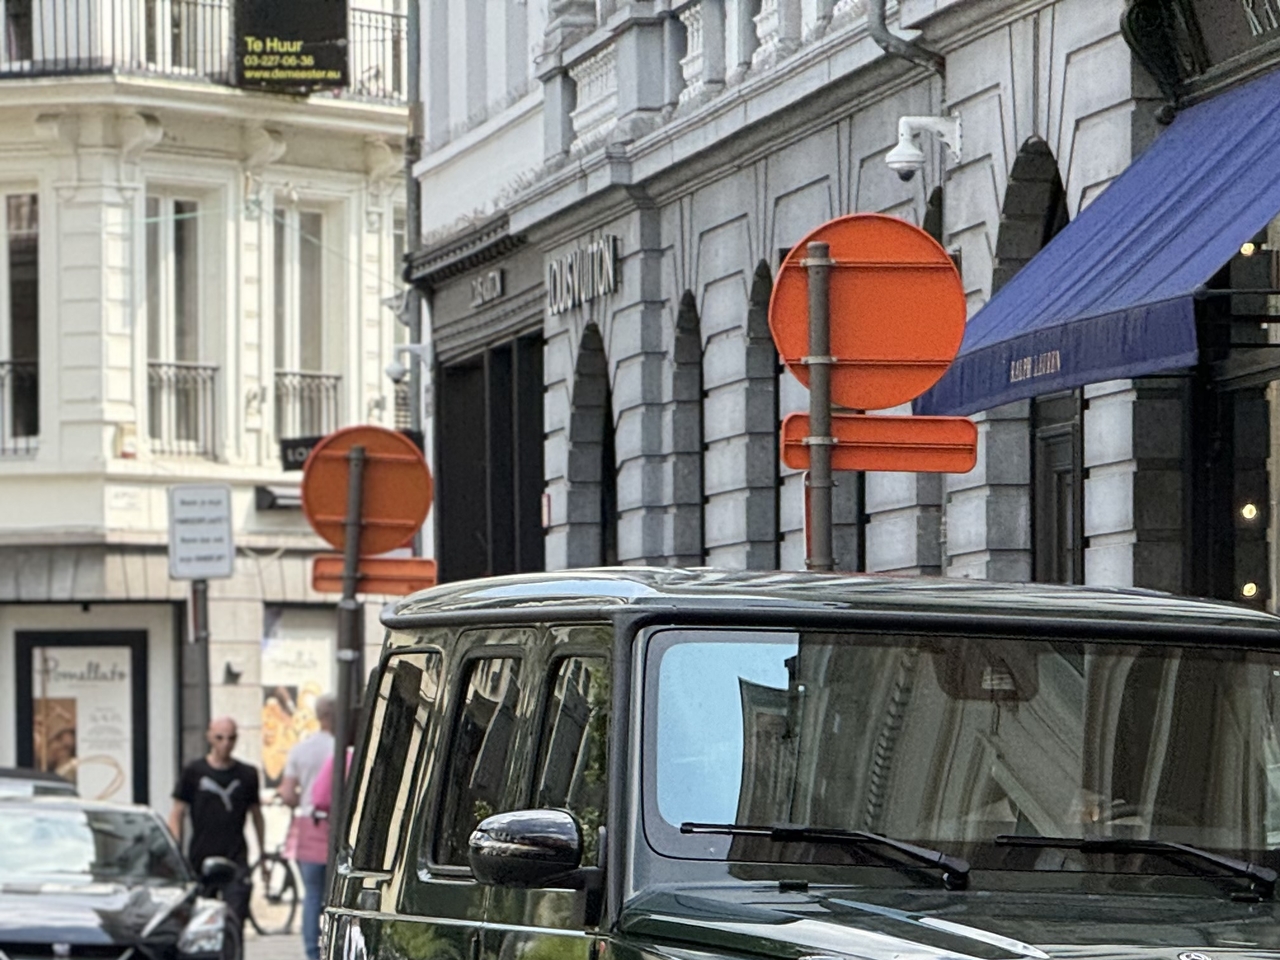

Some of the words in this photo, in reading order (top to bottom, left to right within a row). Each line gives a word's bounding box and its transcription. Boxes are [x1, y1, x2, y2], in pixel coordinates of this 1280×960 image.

[244, 37, 263, 52] Te
[266, 37, 303, 52] Huur
[286, 447, 314, 462] LO
